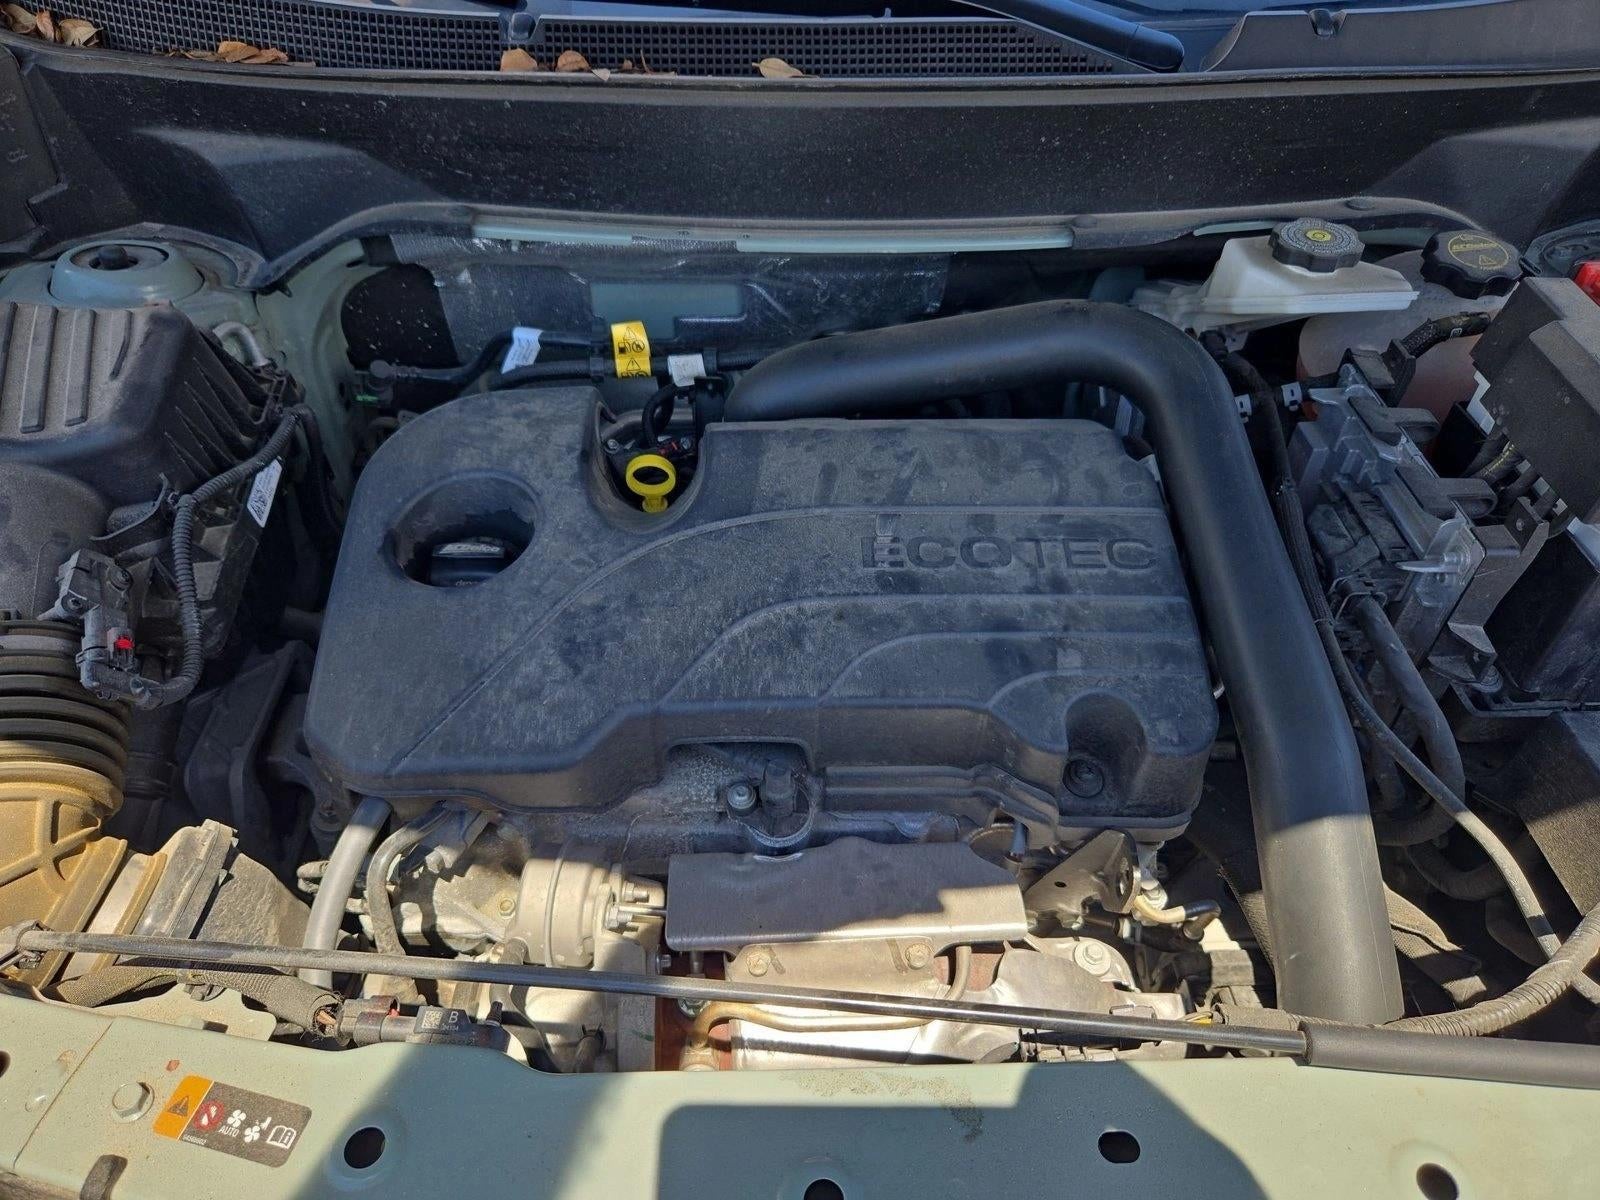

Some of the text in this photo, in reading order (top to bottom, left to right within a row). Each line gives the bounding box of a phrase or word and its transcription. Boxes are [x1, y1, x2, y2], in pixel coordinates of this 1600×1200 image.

[860, 536, 1154, 569] ECOTEC
[449, 1011, 459, 1023] B
[217, 1125, 240, 1138] AUTO
